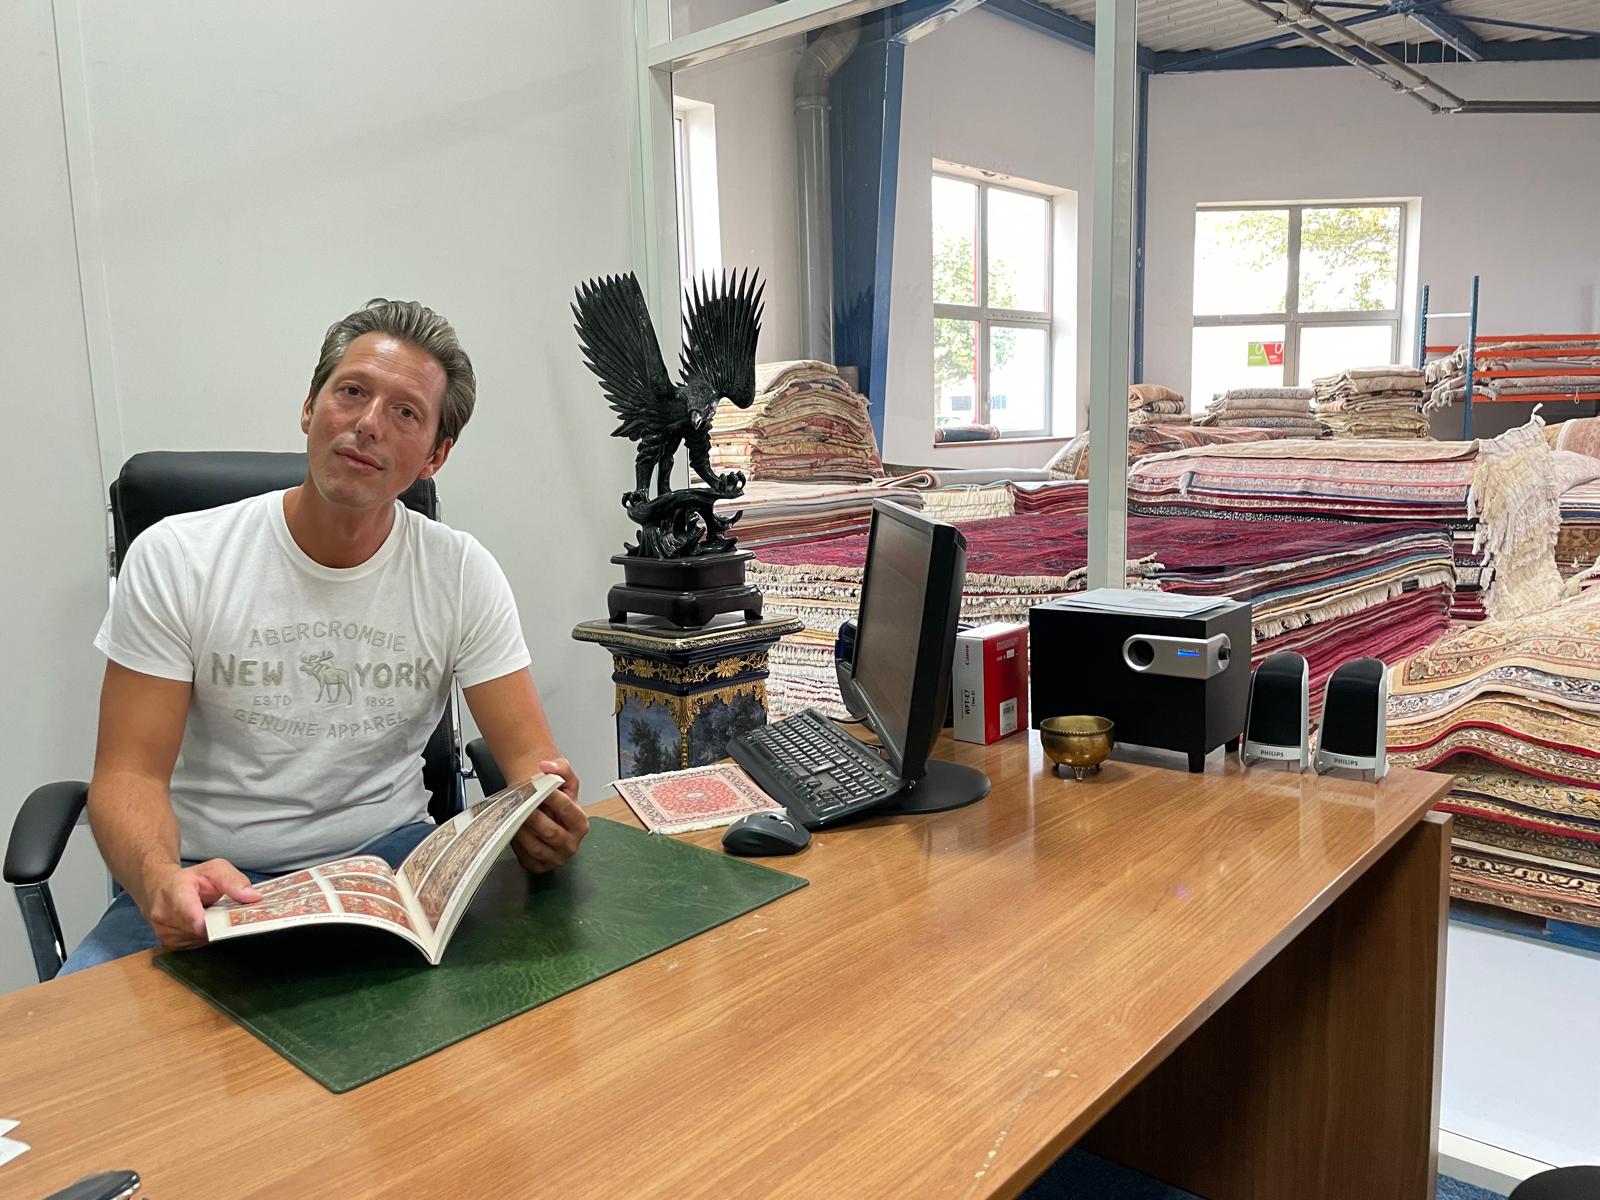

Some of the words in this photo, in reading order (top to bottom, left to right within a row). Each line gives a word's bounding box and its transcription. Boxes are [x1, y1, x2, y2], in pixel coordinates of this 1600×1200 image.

[248, 620, 408, 652] ABERCROMBIE
[211, 652, 284, 688] NEW
[354, 656, 435, 690] YORK
[253, 695, 293, 706] ESTD
[366, 696, 395, 707] 1892
[233, 708, 319, 736] GENUINE
[326, 711, 409, 739] APPAREL
[1260, 750, 1284, 758] PHILIPS
[1333, 757, 1359, 767] PHILIPS
